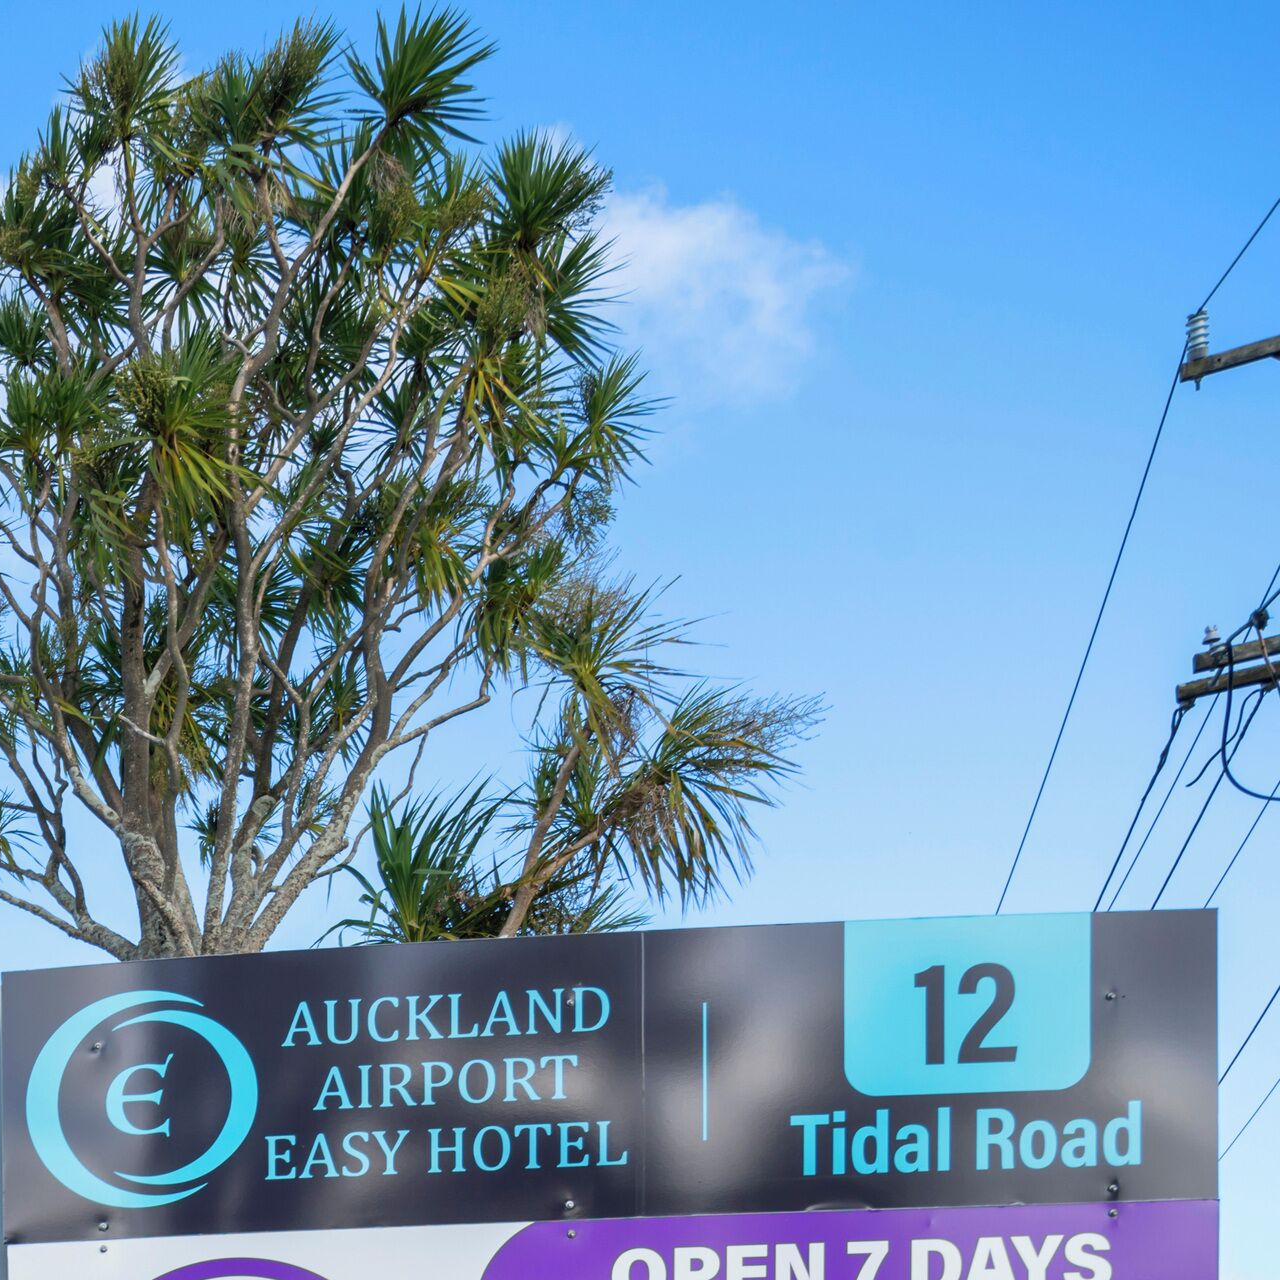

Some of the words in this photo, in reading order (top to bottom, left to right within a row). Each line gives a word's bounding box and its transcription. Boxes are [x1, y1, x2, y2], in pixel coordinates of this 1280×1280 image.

[281, 985, 611, 1048] AUCKLAND
[913, 962, 1018, 1066] 12
[313, 1054, 579, 1111] AIRPORT
[265, 1129, 410, 1181] EASY
[428, 1119, 629, 1174] HOTEL
[790, 1106, 951, 1176] Tidal
[976, 1100, 1142, 1171] Road
